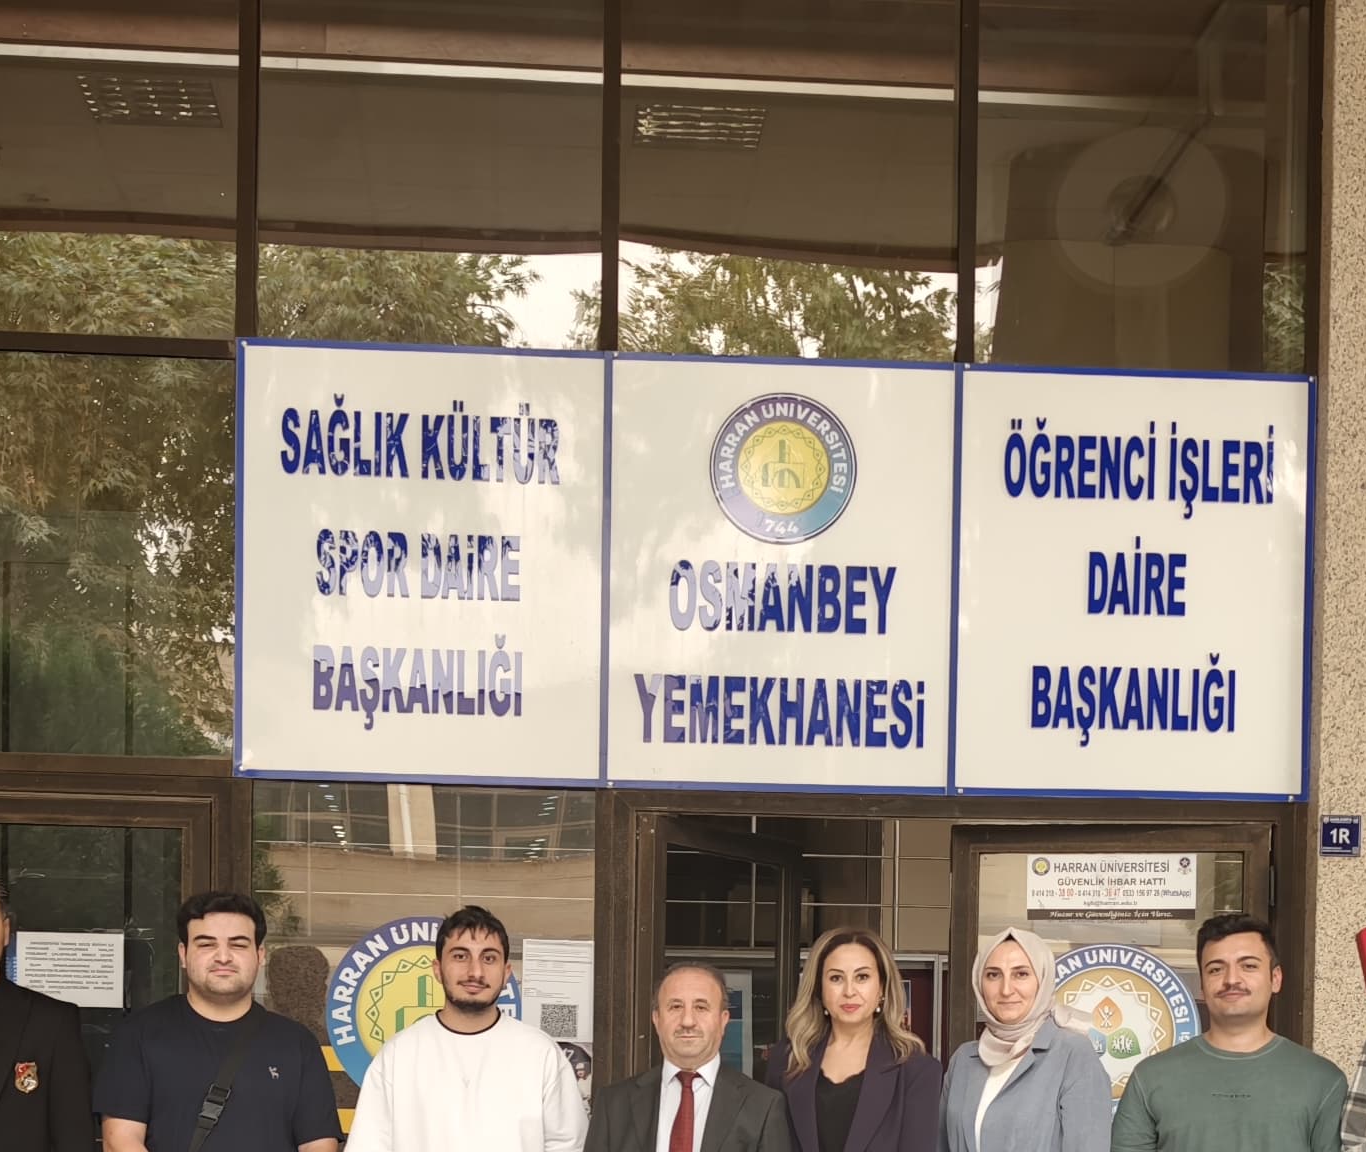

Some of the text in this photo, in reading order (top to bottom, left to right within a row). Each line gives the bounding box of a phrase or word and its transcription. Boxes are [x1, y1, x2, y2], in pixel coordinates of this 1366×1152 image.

[280, 393, 560, 485] SAĞLIK KÜLTÜR
[719, 410, 760, 489] HARRAN
[1003, 417, 1275, 520] ÖĞRENCİ İŞLERİ
[315, 528, 410, 599] SPOR
[764, 518, 799, 535] 744
[669, 559, 898, 635] OSMANBEY
[1087, 536, 1187, 617] DAİRE
[312, 633, 523, 731] BAŞKANLIĞI
[1030, 652, 1236, 748] BAŞKANLIĞI
[1053, 859, 1170, 873] HARRAN ÜNİVERSİTESİ
[1330, 828, 1351, 845] 1R
[1057, 876, 1166, 886] GÜVENLİK İHBAR HATTI
[332, 933, 389, 1046] HARRAN
